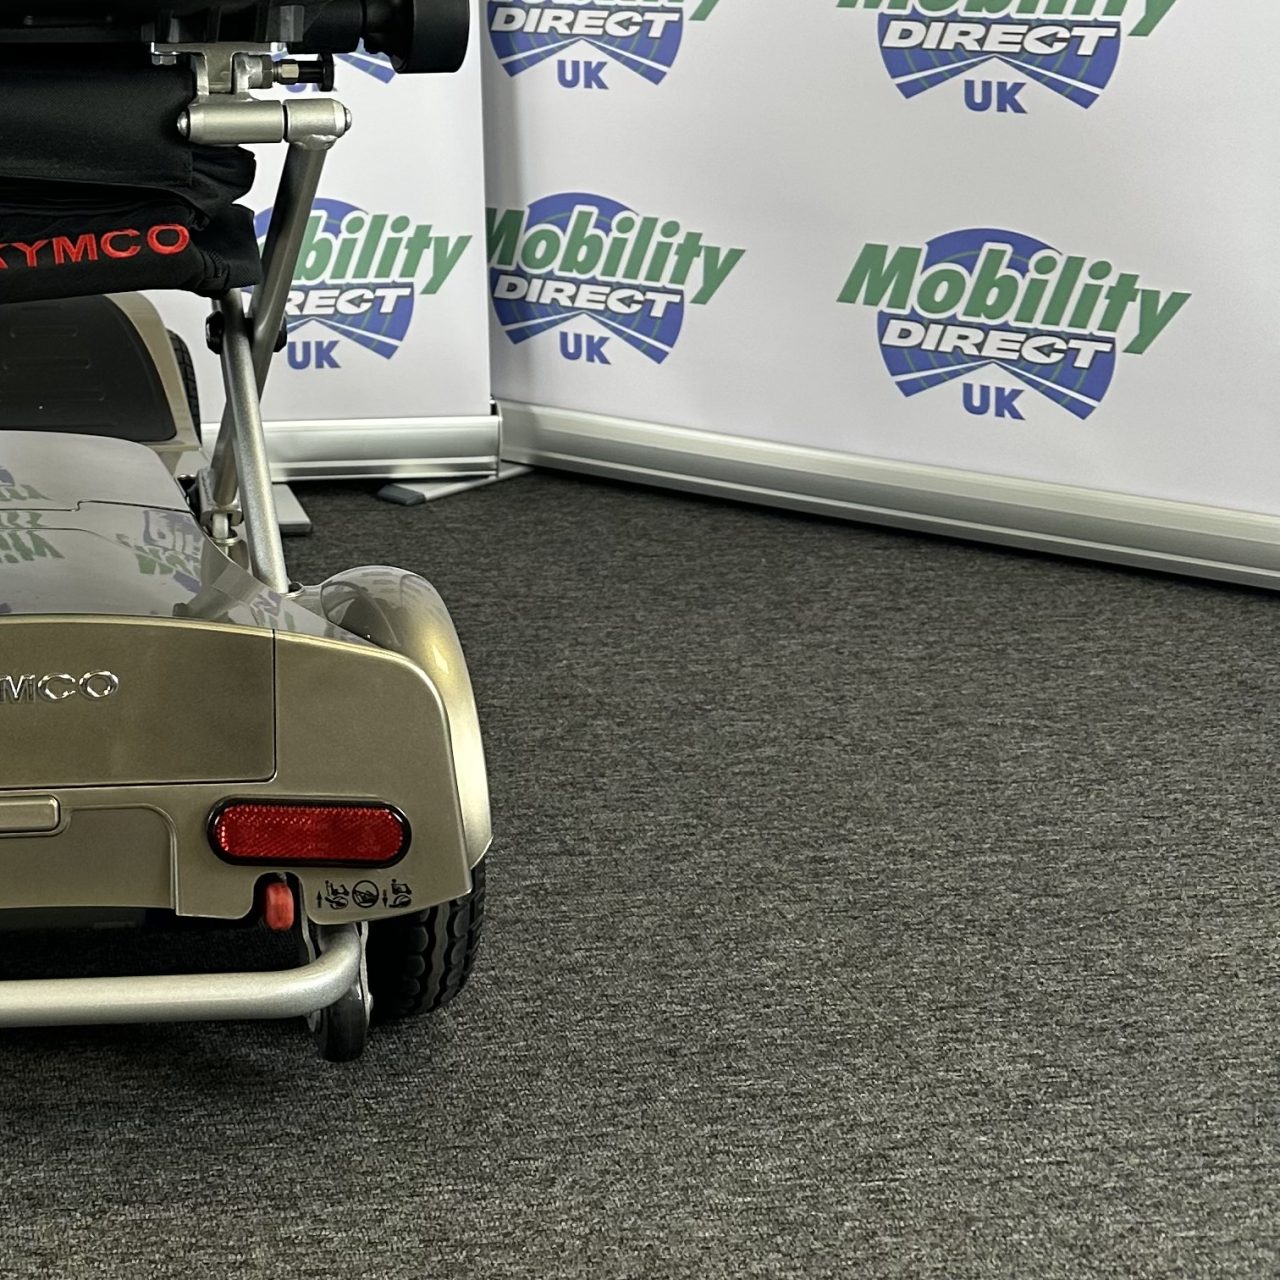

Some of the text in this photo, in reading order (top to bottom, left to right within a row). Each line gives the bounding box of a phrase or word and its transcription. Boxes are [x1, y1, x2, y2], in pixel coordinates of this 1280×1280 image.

[490, 6, 680, 38] DIRECT
[881, 21, 1118, 56] DIRECT
[556, 60, 609, 89] UK
[964, 80, 1027, 114] UK
[493, 274, 681, 318] DIRECT
[836, 243, 1193, 355] Mobility
[287, 340, 341, 370] UK
[559, 331, 612, 365] UK
[881, 319, 1113, 368] DIRECT
[962, 383, 1026, 420] UK
